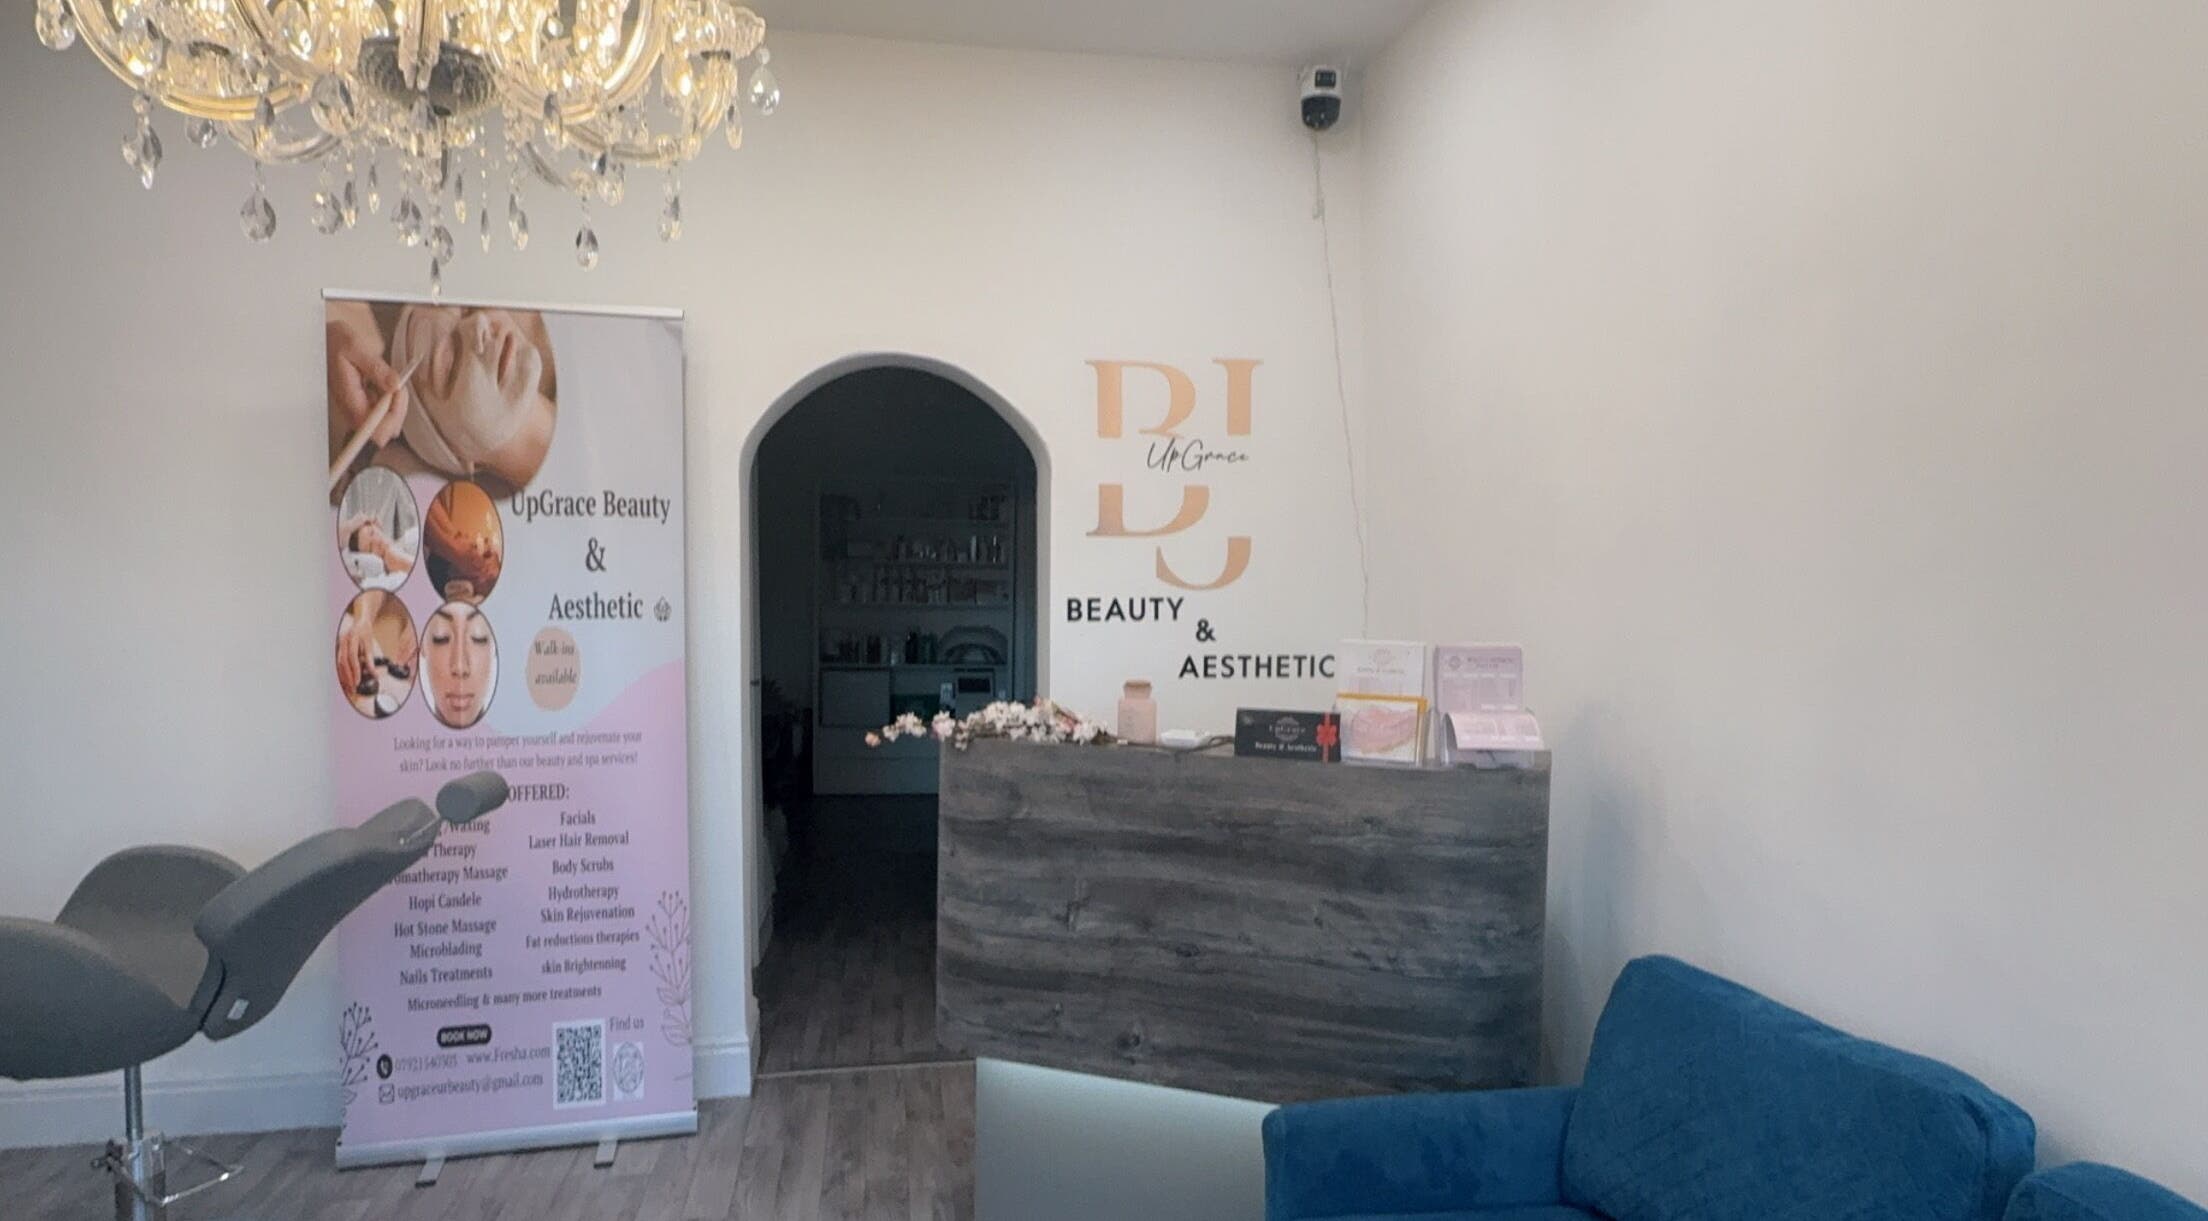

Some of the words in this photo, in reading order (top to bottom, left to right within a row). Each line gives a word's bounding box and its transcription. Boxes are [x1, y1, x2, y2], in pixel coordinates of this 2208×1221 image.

[1146, 437, 1250, 473] UpGrace
[511, 489, 597, 523] UpGrace
[603, 490, 671, 525] Beauty
[585, 537, 606, 573] &
[549, 592, 645, 621] Aesthetic
[1066, 597, 1184, 622] BEAUTY
[1195, 618, 1216, 642] &
[535, 666, 577, 685] available
[1178, 655, 1335, 679] AESTHETIC
[393, 737, 431, 752] Looking
[432, 736, 448, 749] for
[455, 738, 473, 751] way
[474, 735, 485, 747] to
[486, 736, 519, 751] pamper
[522, 732, 556, 749] yourself
[559, 732, 575, 746] and
[577, 732, 621, 748] rejuvenate
[622, 732, 642, 746] your
[400, 757, 423, 773] skin?
[425, 756, 446, 771] Look
[450, 759, 462, 770] no
[464, 755, 494, 771] further
[496, 755, 517, 769] than
[519, 758, 534, 768] our
[536, 754, 567, 769] beauty
[567, 753, 584, 766] and
[585, 756, 599, 769] spa
[601, 751, 637, 766] services!
[507, 782, 569, 801] OFFERED:
[560, 809, 596, 826] Facials
[528, 834, 556, 849] Laser
[559, 832, 582, 847] Hair
[585, 829, 629, 846] Removal
[432, 843, 477, 859] Therapy
[463, 865, 509, 882] Massage
[552, 858, 577, 876] Body
[580, 856, 614, 872] Scrubs
[408, 894, 436, 912] Hopi
[438, 891, 482, 909] Candele
[548, 884, 619, 902] Hydrotherapy
[540, 907, 564, 923] Skin
[566, 905, 635, 923] Rejuvenation
[394, 922, 414, 938] Hot
[417, 920, 449, 937] Stone
[451, 918, 497, 935] Massage
[526, 934, 541, 949] Fat
[543, 932, 594, 948] reductions
[596, 929, 640, 945] therapies
[410, 941, 482, 959] Microblading
[400, 968, 428, 985] Nails
[430, 966, 493, 983] Treatments
[541, 960, 562, 974] skin
[407, 993, 480, 1012] Microneedling
[482, 993, 490, 1006] &
[493, 992, 520, 1007] many
[522, 990, 548, 1003] more
[549, 986, 602, 1001] treatments
[609, 1015, 631, 1032] Find
[632, 1018, 645, 1030] us
[440, 1031, 465, 1043] BOOK
[466, 1028, 489, 1041] NOW
